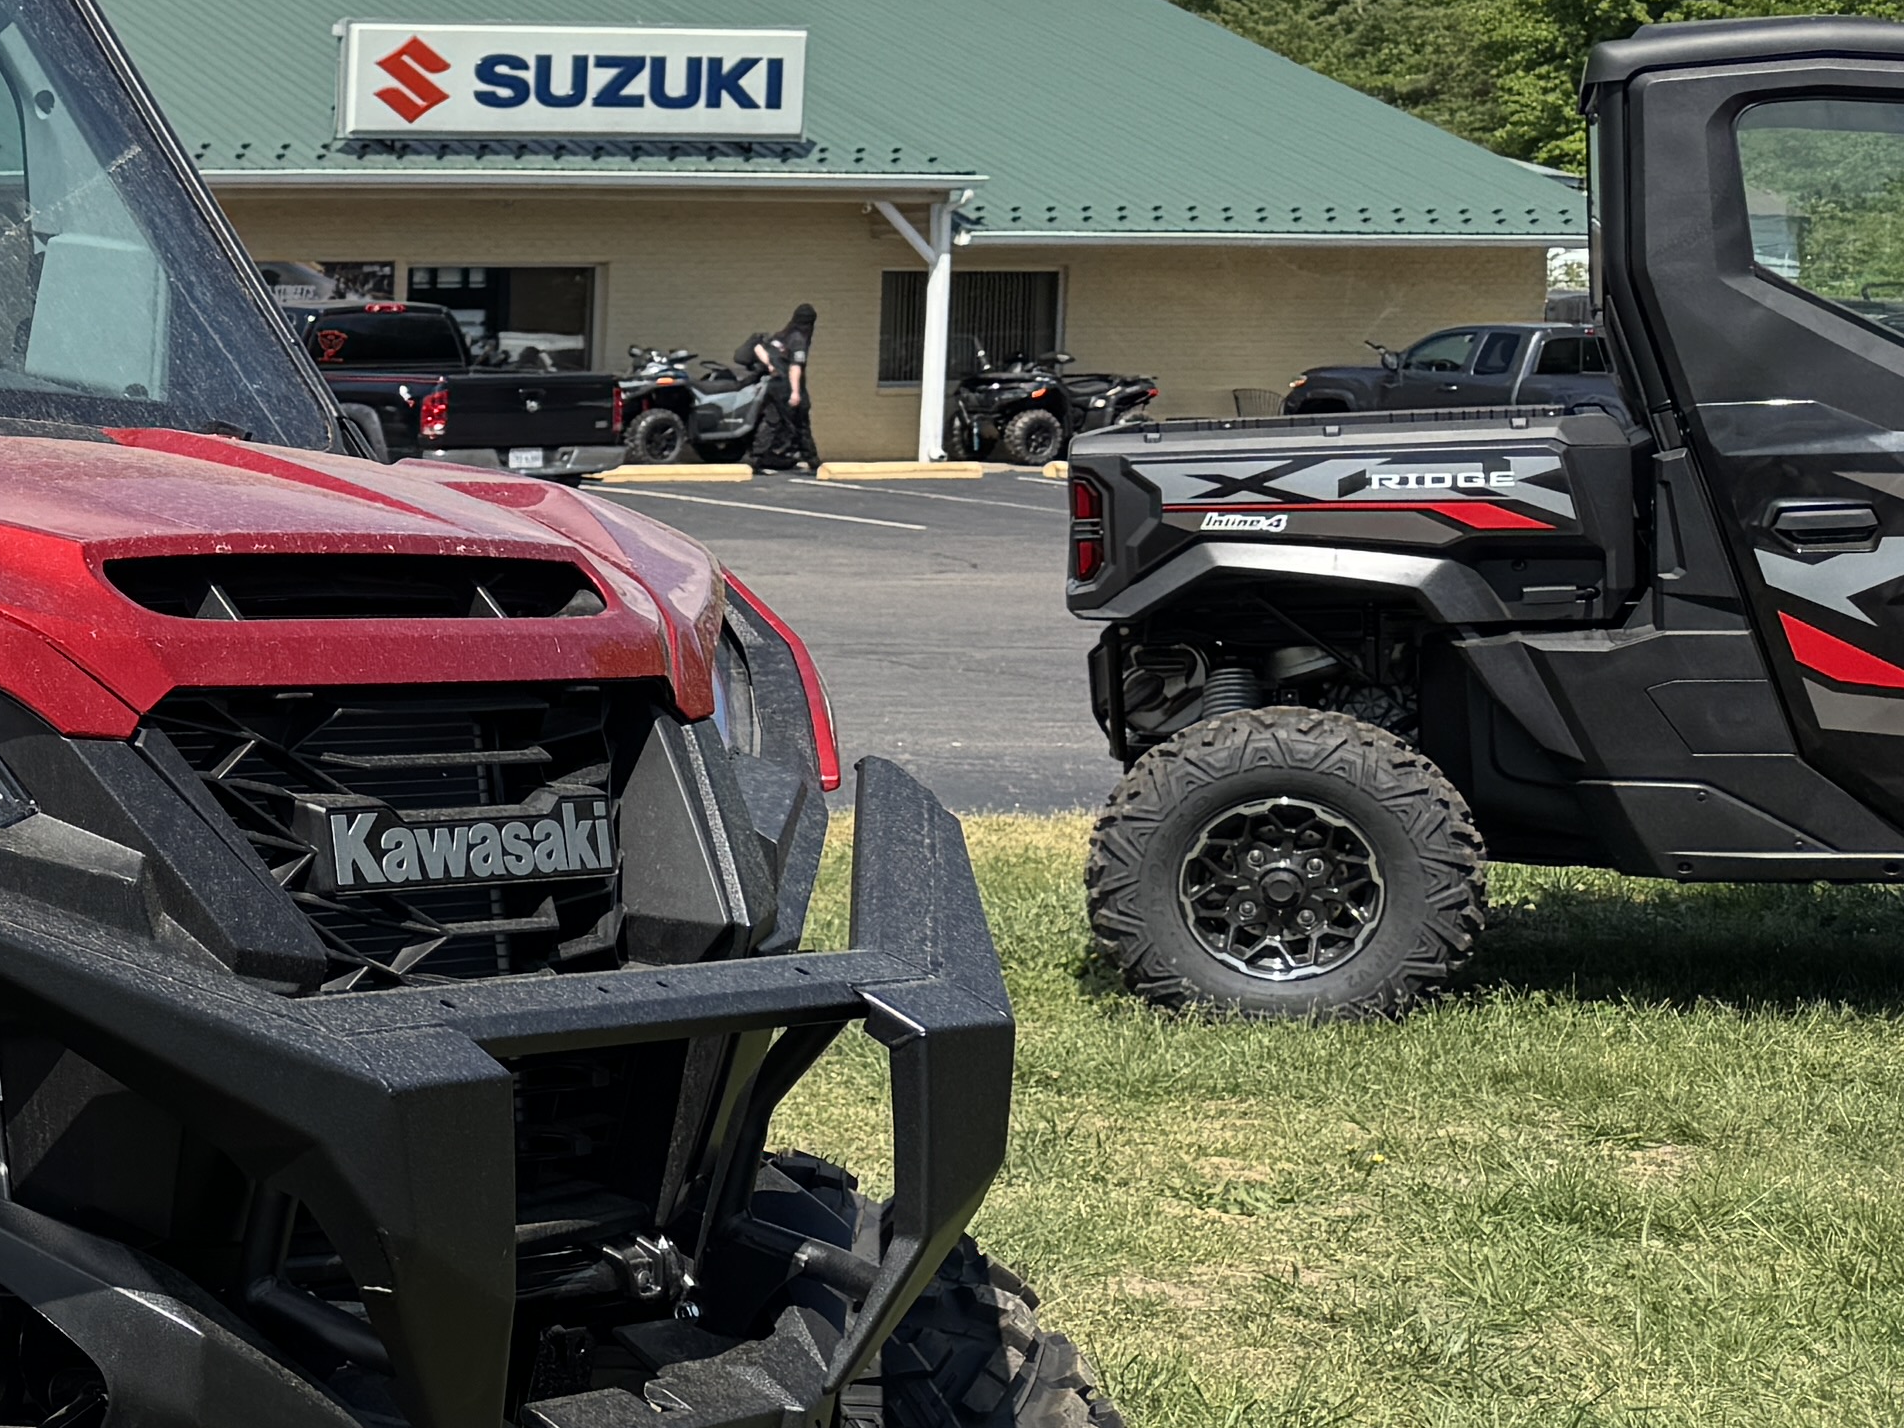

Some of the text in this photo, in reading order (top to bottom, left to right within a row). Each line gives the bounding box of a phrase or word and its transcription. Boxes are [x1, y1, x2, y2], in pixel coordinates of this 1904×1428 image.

[473, 53, 783, 111] SUZUKI
[1370, 471, 1516, 489] RIDGE
[331, 801, 612, 885] Kawasaki
